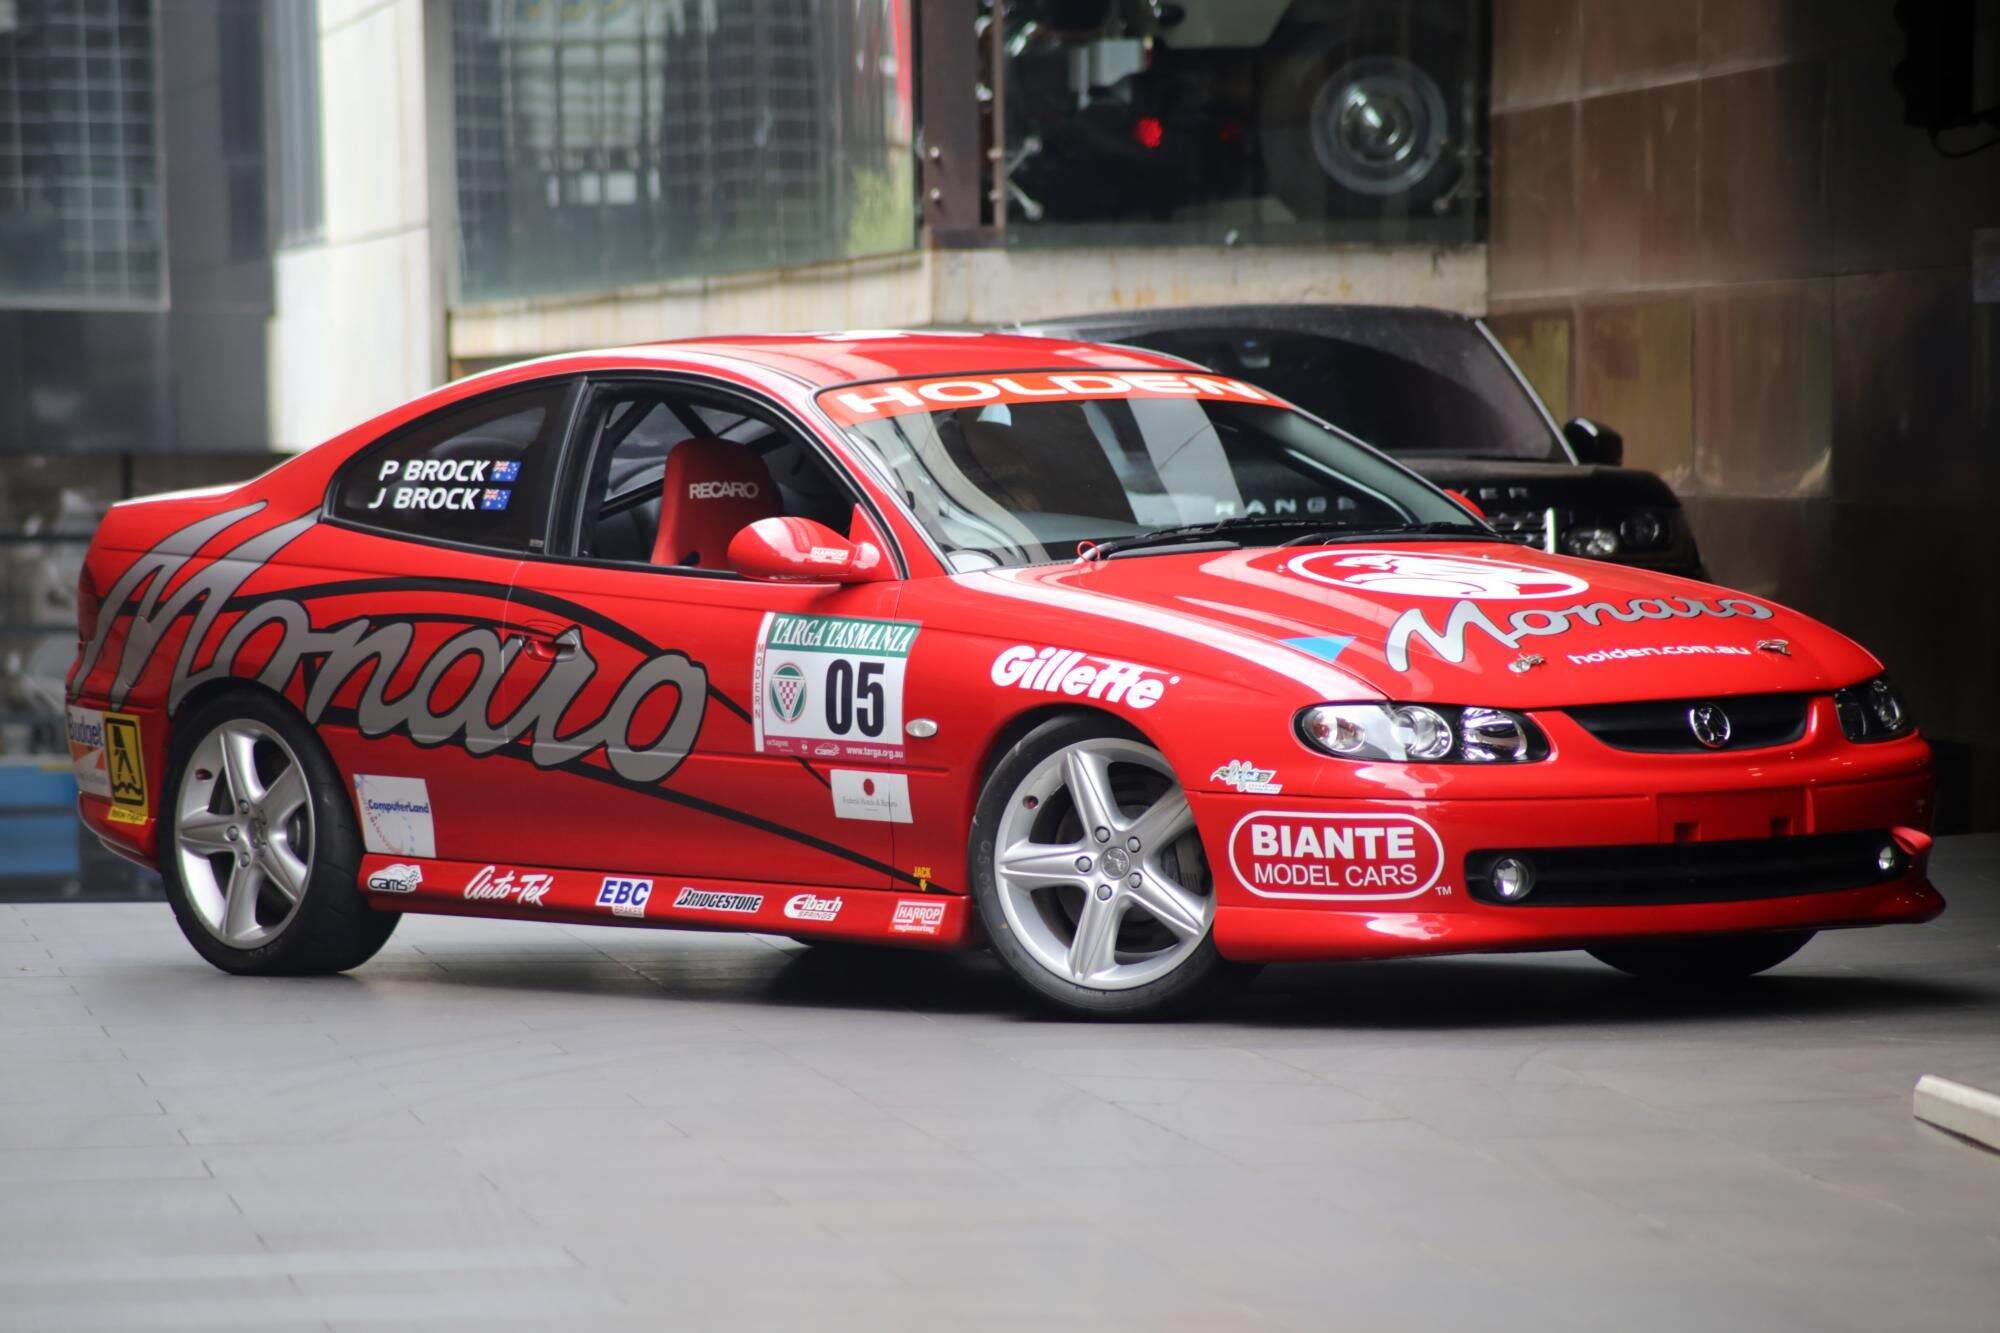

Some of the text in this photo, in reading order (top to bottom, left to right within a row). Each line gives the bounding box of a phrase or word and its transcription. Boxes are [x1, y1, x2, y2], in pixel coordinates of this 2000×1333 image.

[836, 374, 1269, 414] HOLDEN
[378, 459, 491, 483] P BROCK
[367, 487, 481, 511] J BROCK
[689, 481, 759, 499] RECARO
[66, 500, 708, 783] Monaro
[771, 617, 916, 653] TARGA TASMANIA
[1385, 596, 1774, 673] Monaro
[1568, 641, 1752, 666] holden.com.au
[991, 644, 1170, 709] Gillette
[825, 658, 885, 738] 05
[368, 799, 430, 814] ComputerLand
[1251, 823, 1417, 860] BIANTE
[914, 866, 931, 879] JACK
[1254, 863, 1418, 887] MODEL CARS
[463, 865, 554, 907] Auto-Tek
[600, 880, 649, 906] EBC
[676, 888, 762, 911] BRIDGESTONE
[899, 905, 941, 921] HARROP
[894, 924, 935, 934] engineering
